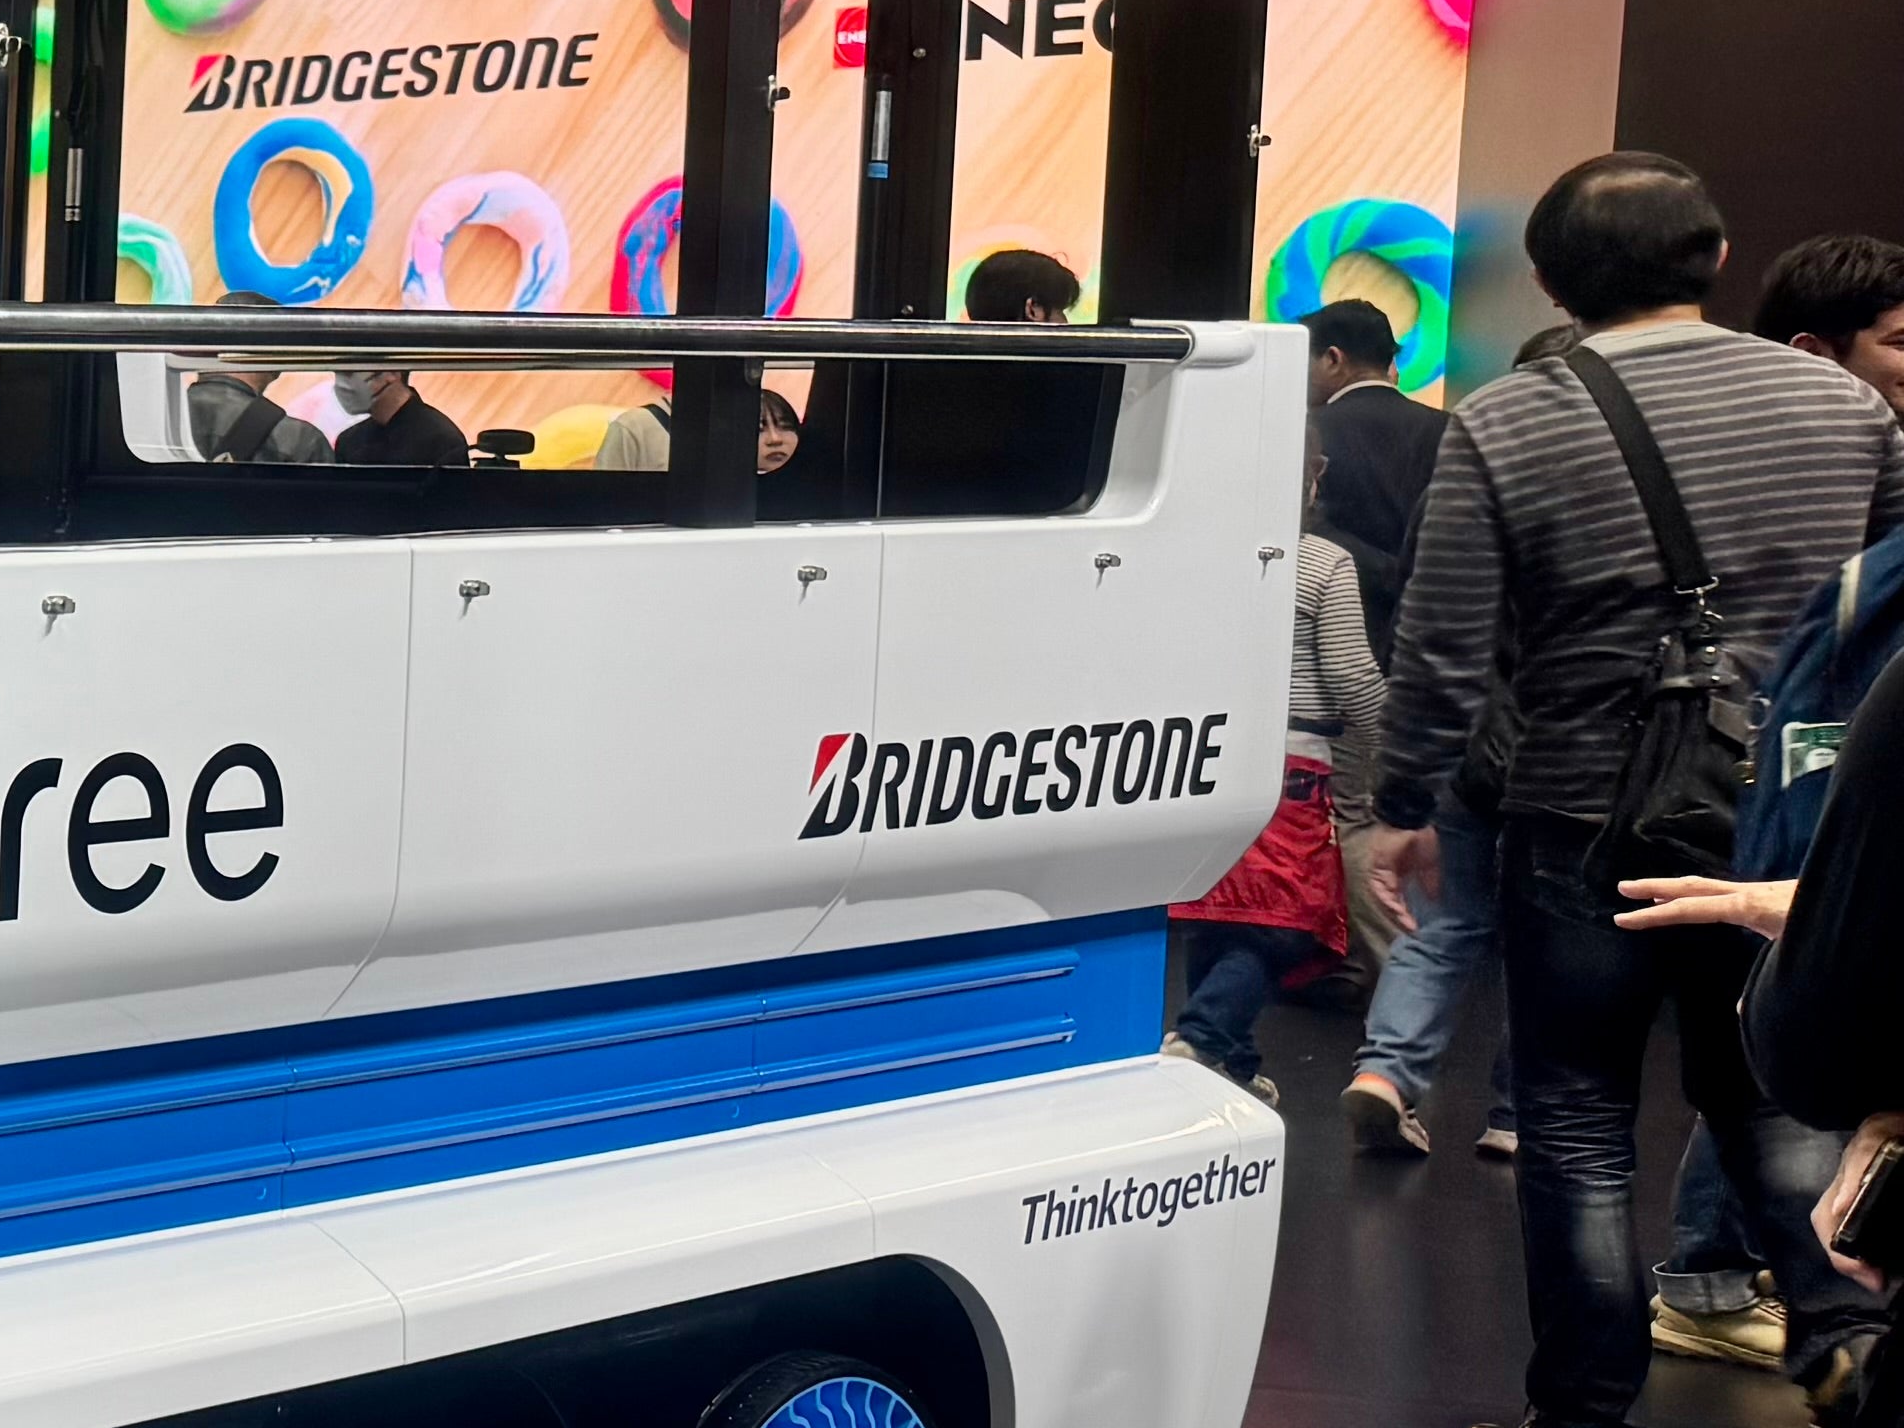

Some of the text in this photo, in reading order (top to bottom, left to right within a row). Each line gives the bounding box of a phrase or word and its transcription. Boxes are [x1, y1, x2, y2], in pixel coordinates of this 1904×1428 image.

[183, 32, 599, 113] BRIDGESTONE
[797, 713, 1228, 840] BRIDGESTONE
[1021, 1153, 1276, 1245] Thinktogether
